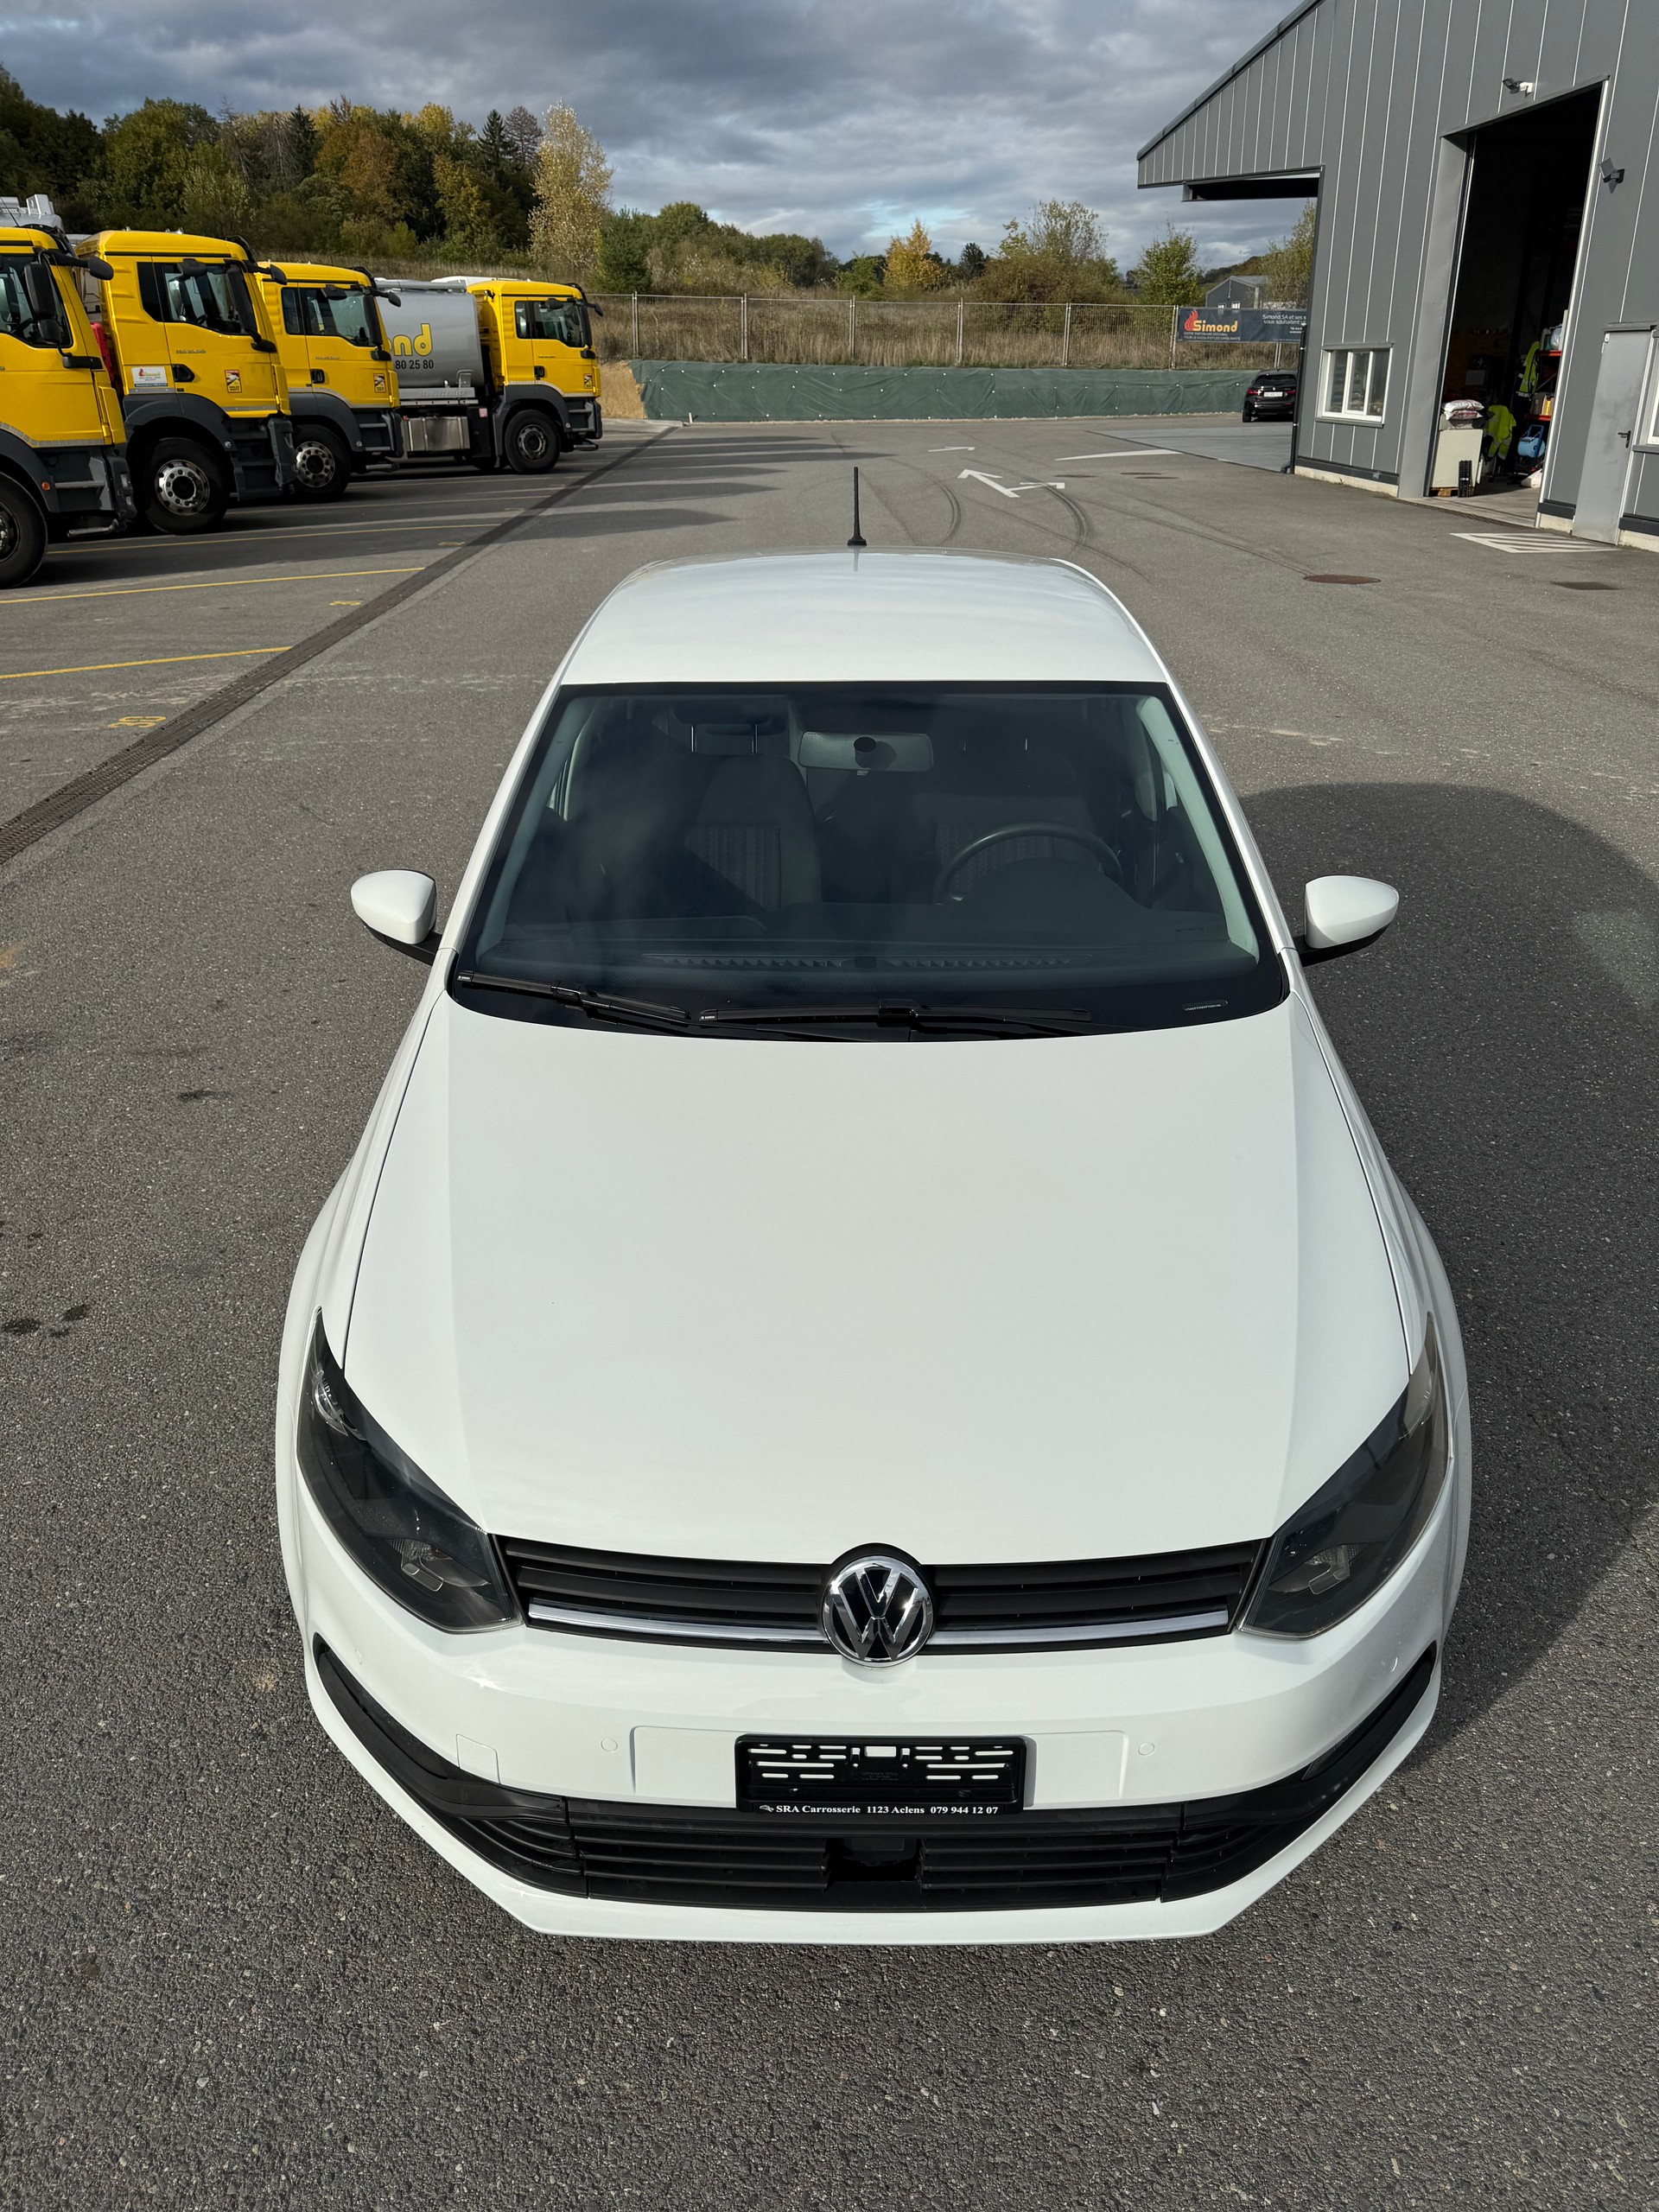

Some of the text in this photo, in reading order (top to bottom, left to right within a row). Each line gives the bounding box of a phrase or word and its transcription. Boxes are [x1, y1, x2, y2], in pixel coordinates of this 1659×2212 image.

[1192, 320, 1238, 333] Simond
[387, 323, 433, 356] nd
[395, 359, 435, 370] 80 25 80
[830, 1563, 925, 1662] VW
[776, 1805, 800, 1814] SRA
[802, 1805, 861, 1814] Carrosserie
[892, 1806, 925, 1815] Aclens
[930, 1806, 949, 1815] 079
[950, 1806, 969, 1815] 944
[971, 1806, 983, 1815] 12
[986, 1806, 999, 1815] 07
